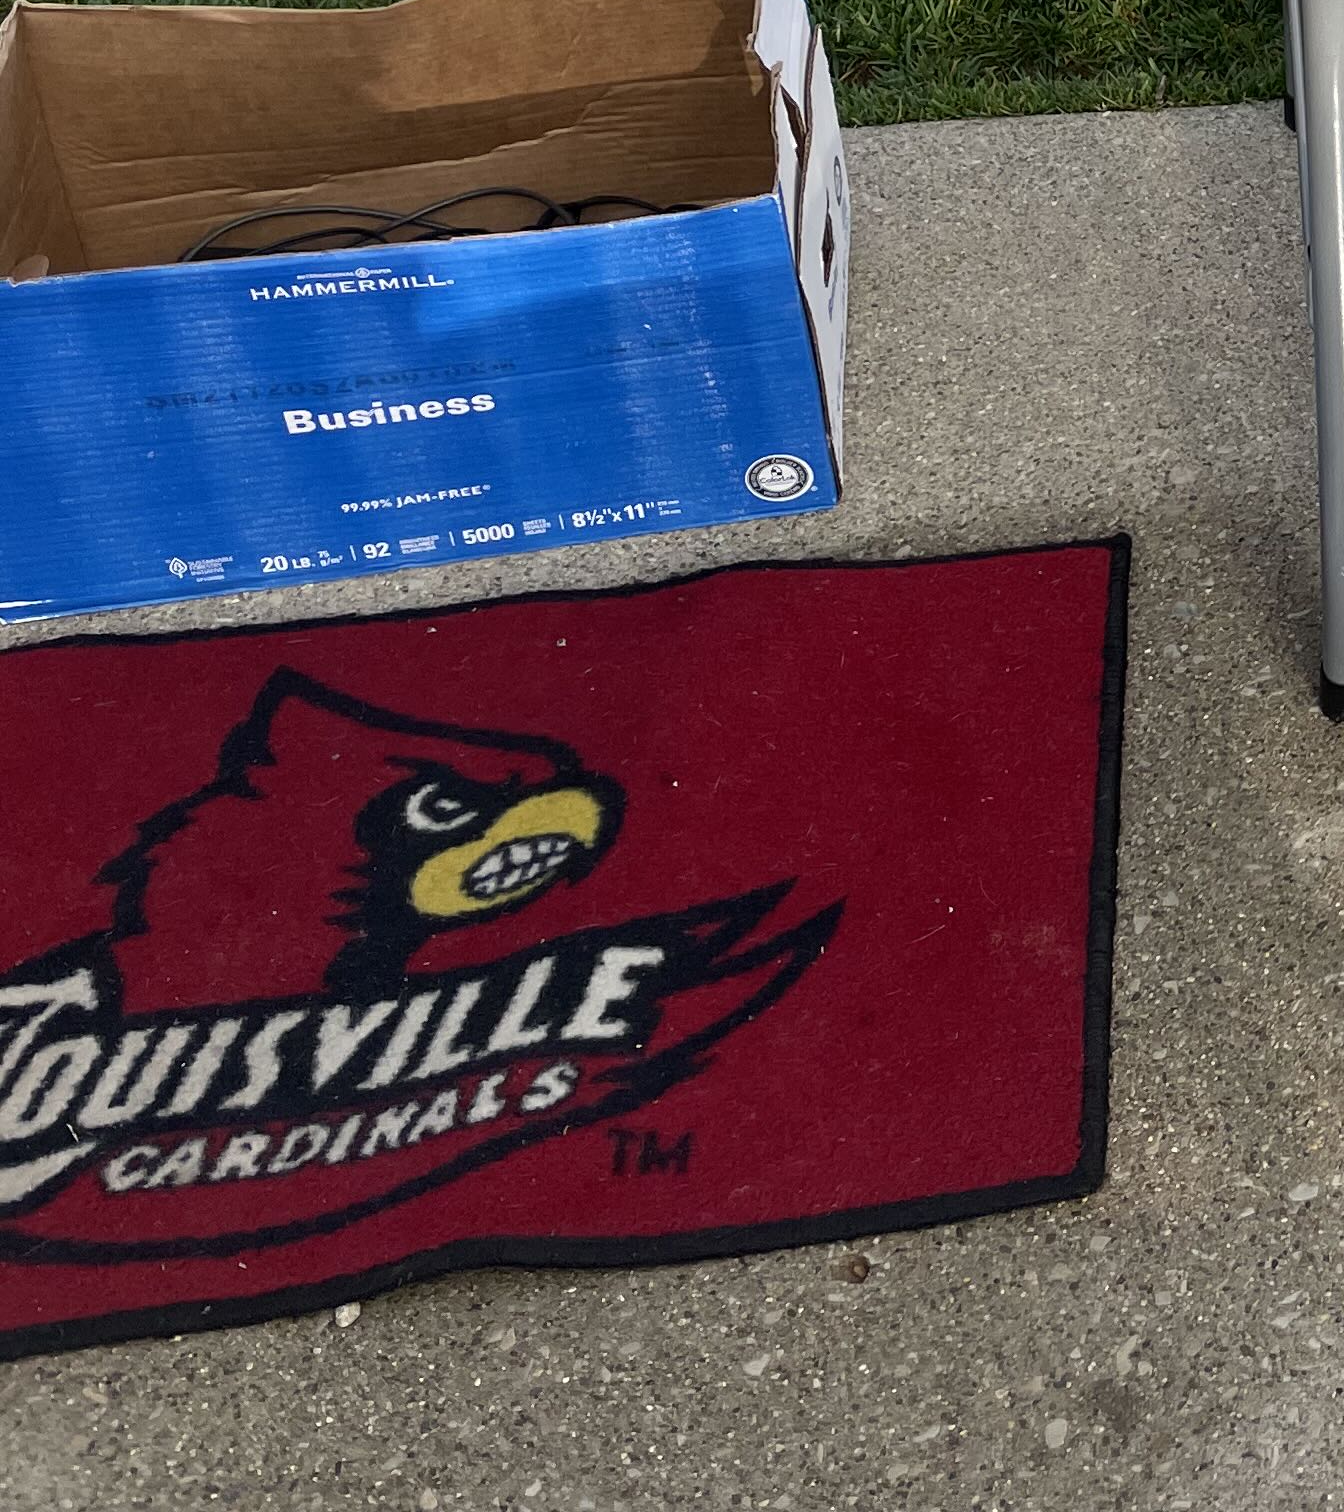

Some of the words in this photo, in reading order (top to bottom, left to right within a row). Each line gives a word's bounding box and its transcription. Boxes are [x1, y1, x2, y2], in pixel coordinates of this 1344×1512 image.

[283, 393, 495, 435] Business
[341, 498, 393, 514] 99.99%
[260, 555, 289, 574] 20
[292, 557, 316, 570] LB.
[363, 542, 392, 560] 92
[462, 523, 516, 545] 5000
[101, 1060, 580, 1194] CARDINALS
[608, 1128, 697, 1177] TM
